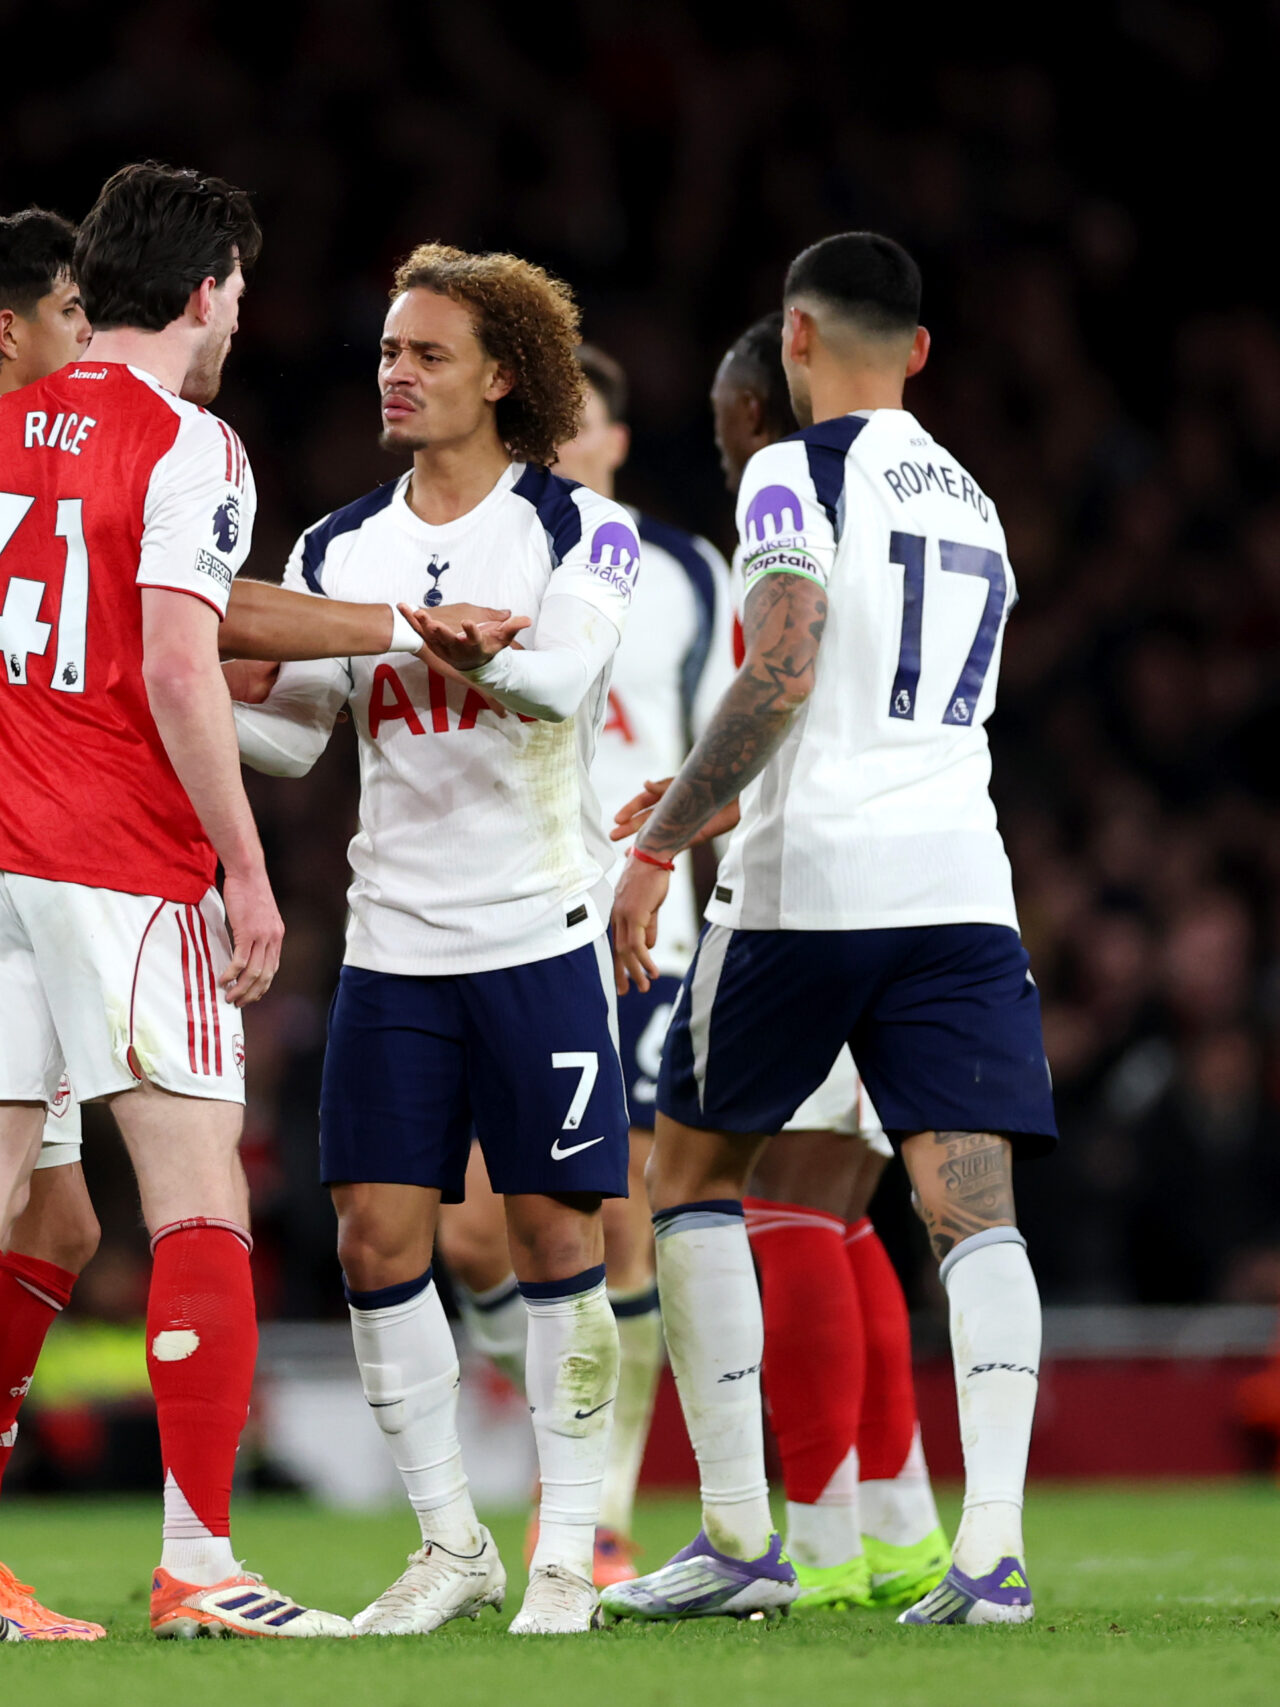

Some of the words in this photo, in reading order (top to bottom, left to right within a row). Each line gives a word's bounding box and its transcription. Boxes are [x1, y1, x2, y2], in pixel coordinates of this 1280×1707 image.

[24, 411, 97, 456] RICE
[884, 461, 989, 523] ROMERO
[197, 549, 213, 566] No
[889, 530, 1007, 727] 17
[551, 1052, 599, 1130] 7
